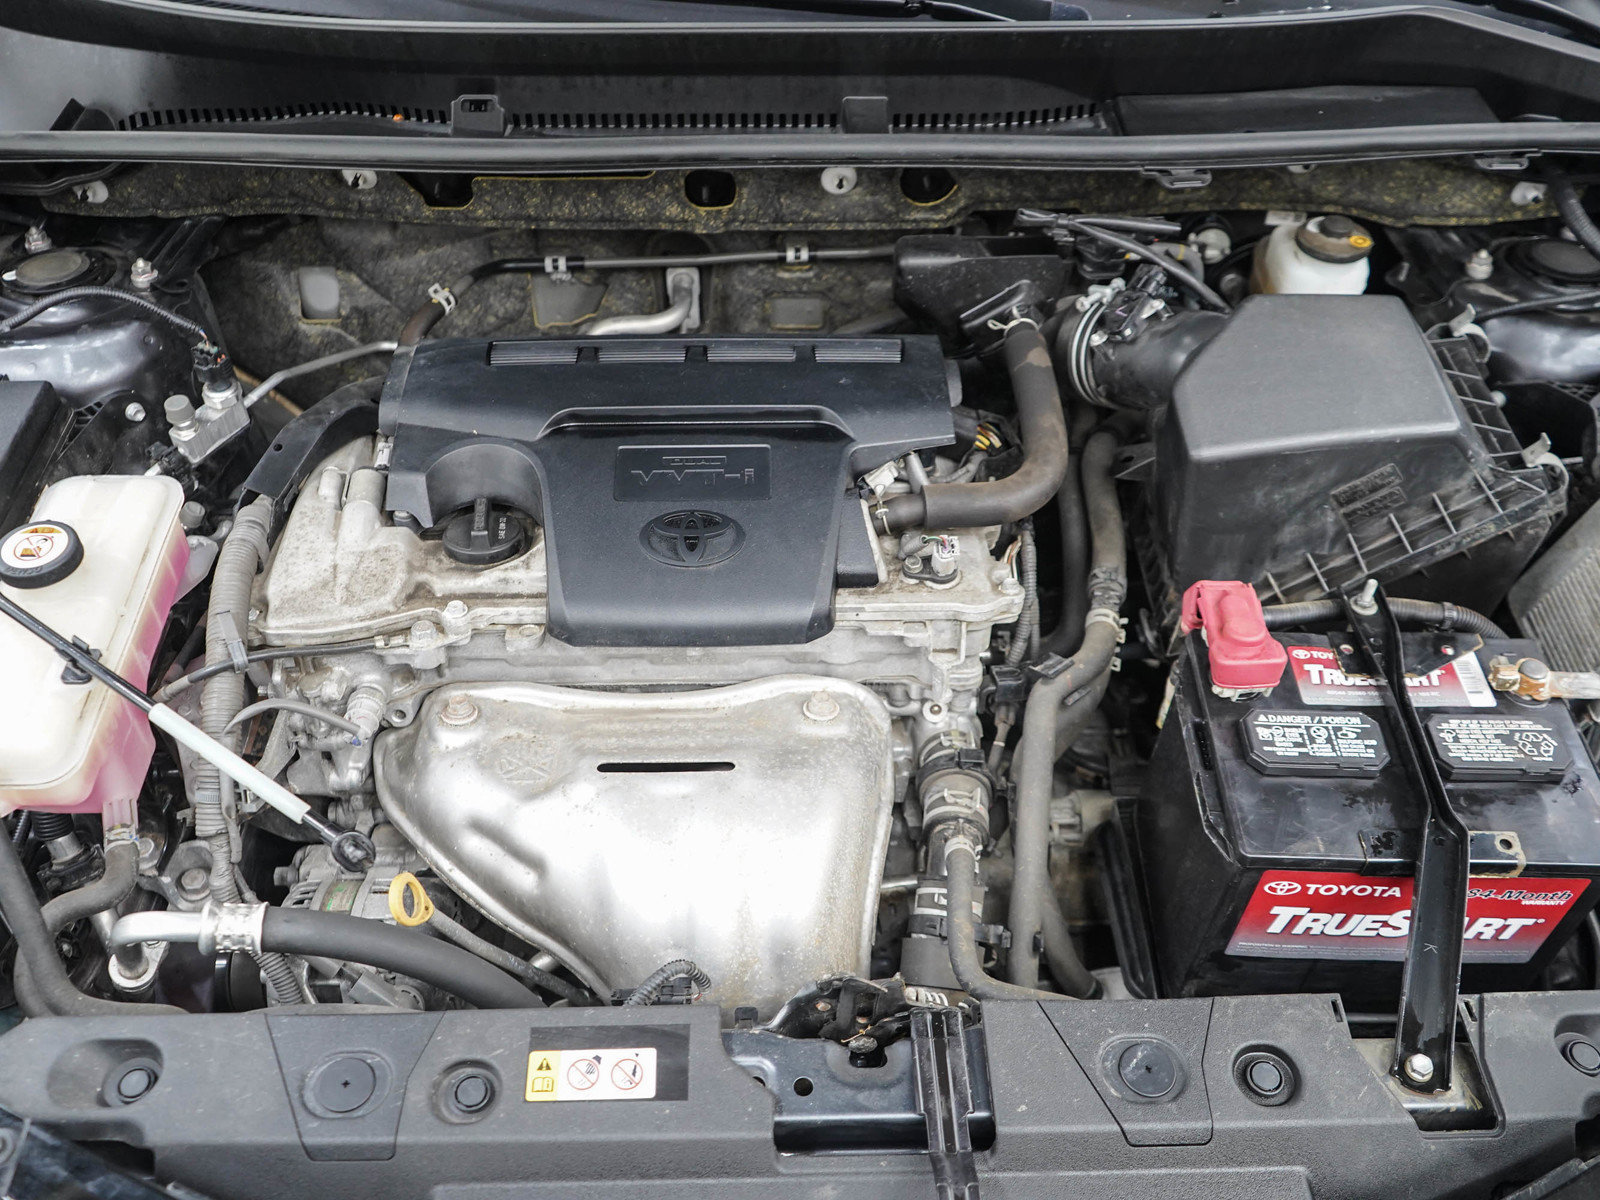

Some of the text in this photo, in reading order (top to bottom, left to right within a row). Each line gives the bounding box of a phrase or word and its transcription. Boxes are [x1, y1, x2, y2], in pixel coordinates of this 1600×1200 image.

[1267, 714, 1312, 724] DANGER
[1320, 716, 1361, 725] POISON
[1305, 883, 1402, 898] TOYOTA
